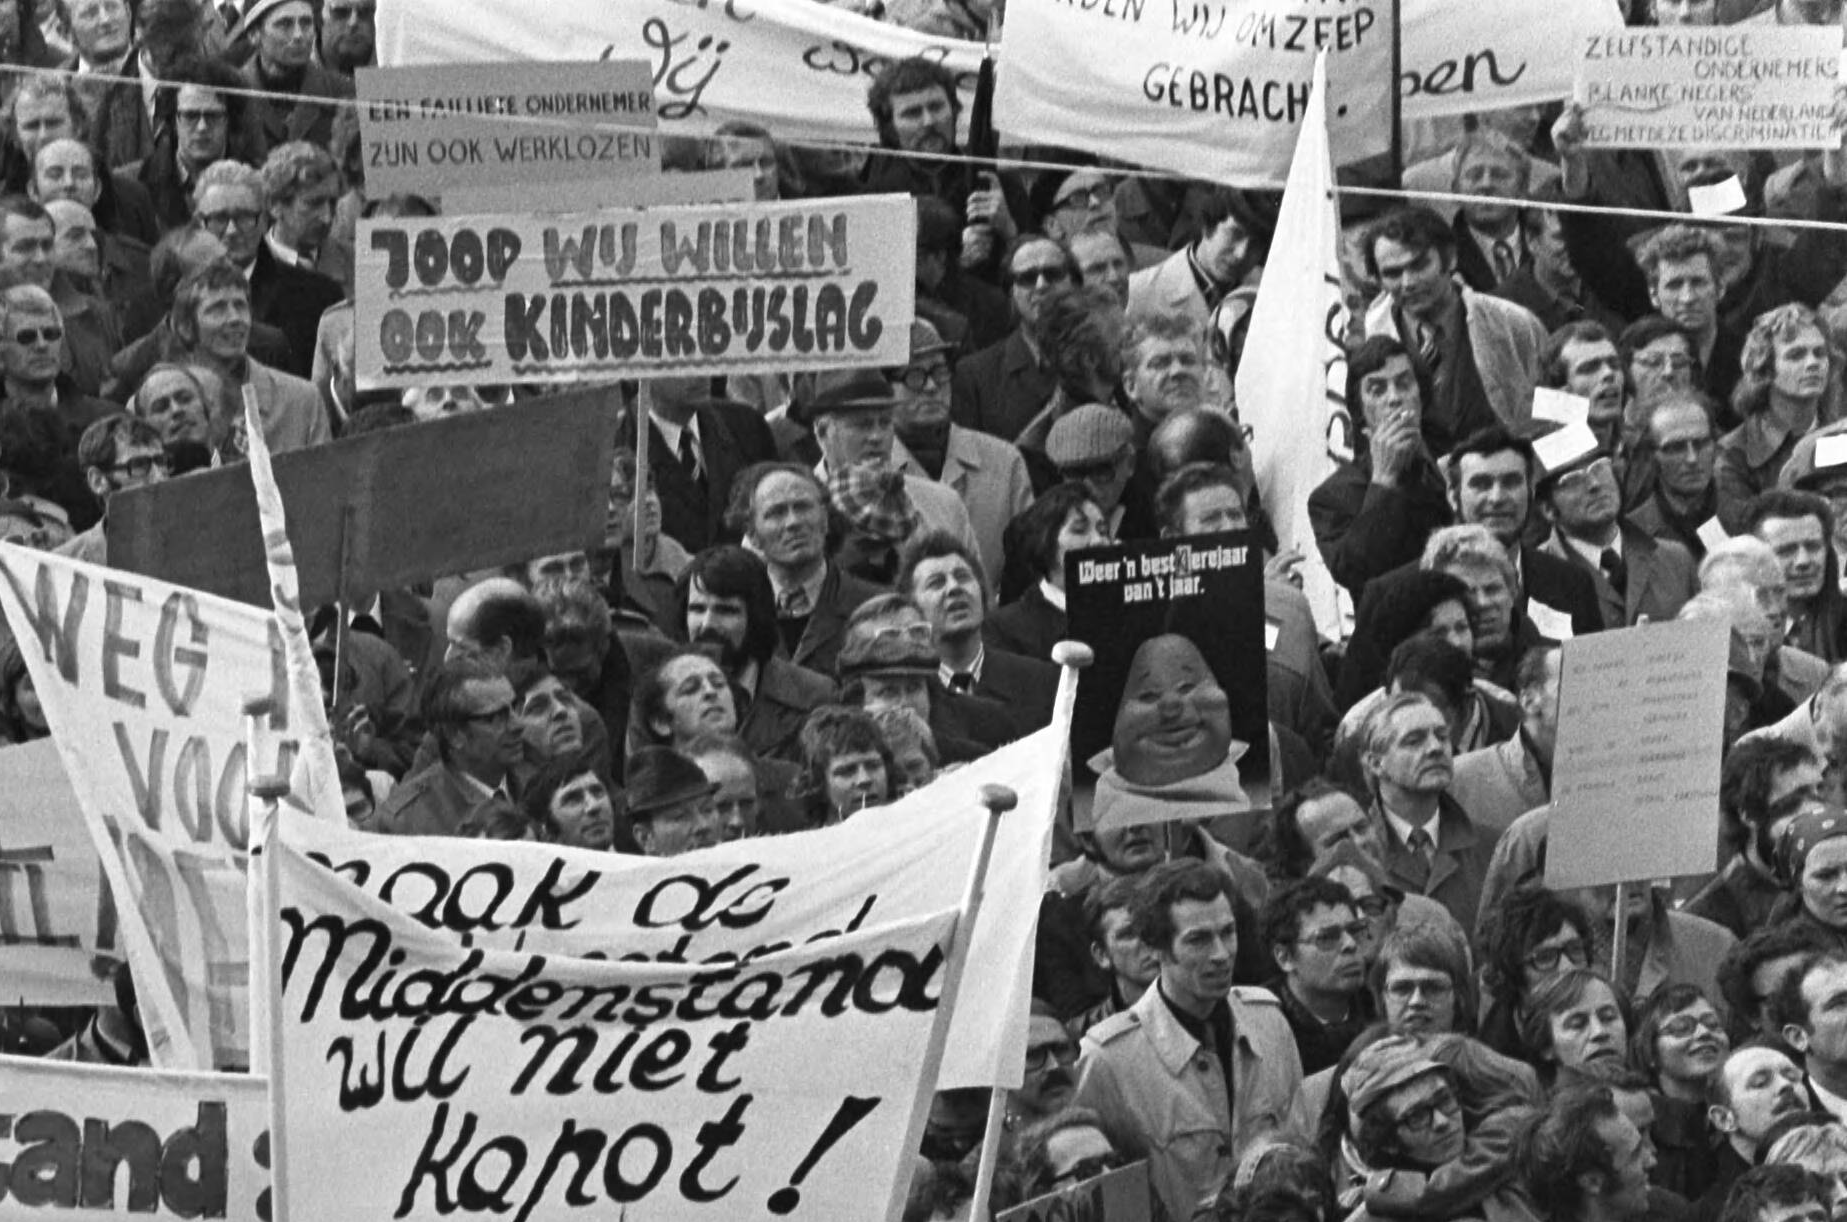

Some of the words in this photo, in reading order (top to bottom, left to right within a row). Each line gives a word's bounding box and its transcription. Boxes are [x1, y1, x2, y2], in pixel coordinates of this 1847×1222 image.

[368, 98, 411, 122] EEN
[525, 90, 652, 116] ONDERNEMER
[1143, 62, 1349, 123] GEBRACH.
[1693, 104, 1733, 121] VAN
[426, 136, 484, 165] OOK
[492, 133, 652, 164] WERKLOZEN
[370, 227, 522, 289] JOOP
[660, 212, 849, 275] WILLEN
[379, 307, 487, 365] OOK
[1078, 559, 1120, 586] Weer
[1141, 553, 1175, 577] best
[1123, 581, 1153, 604] van
[1169, 573, 1205, 601] jaar.
[327, 1014, 474, 1112] wil
[510, 1020, 751, 1096] niet
